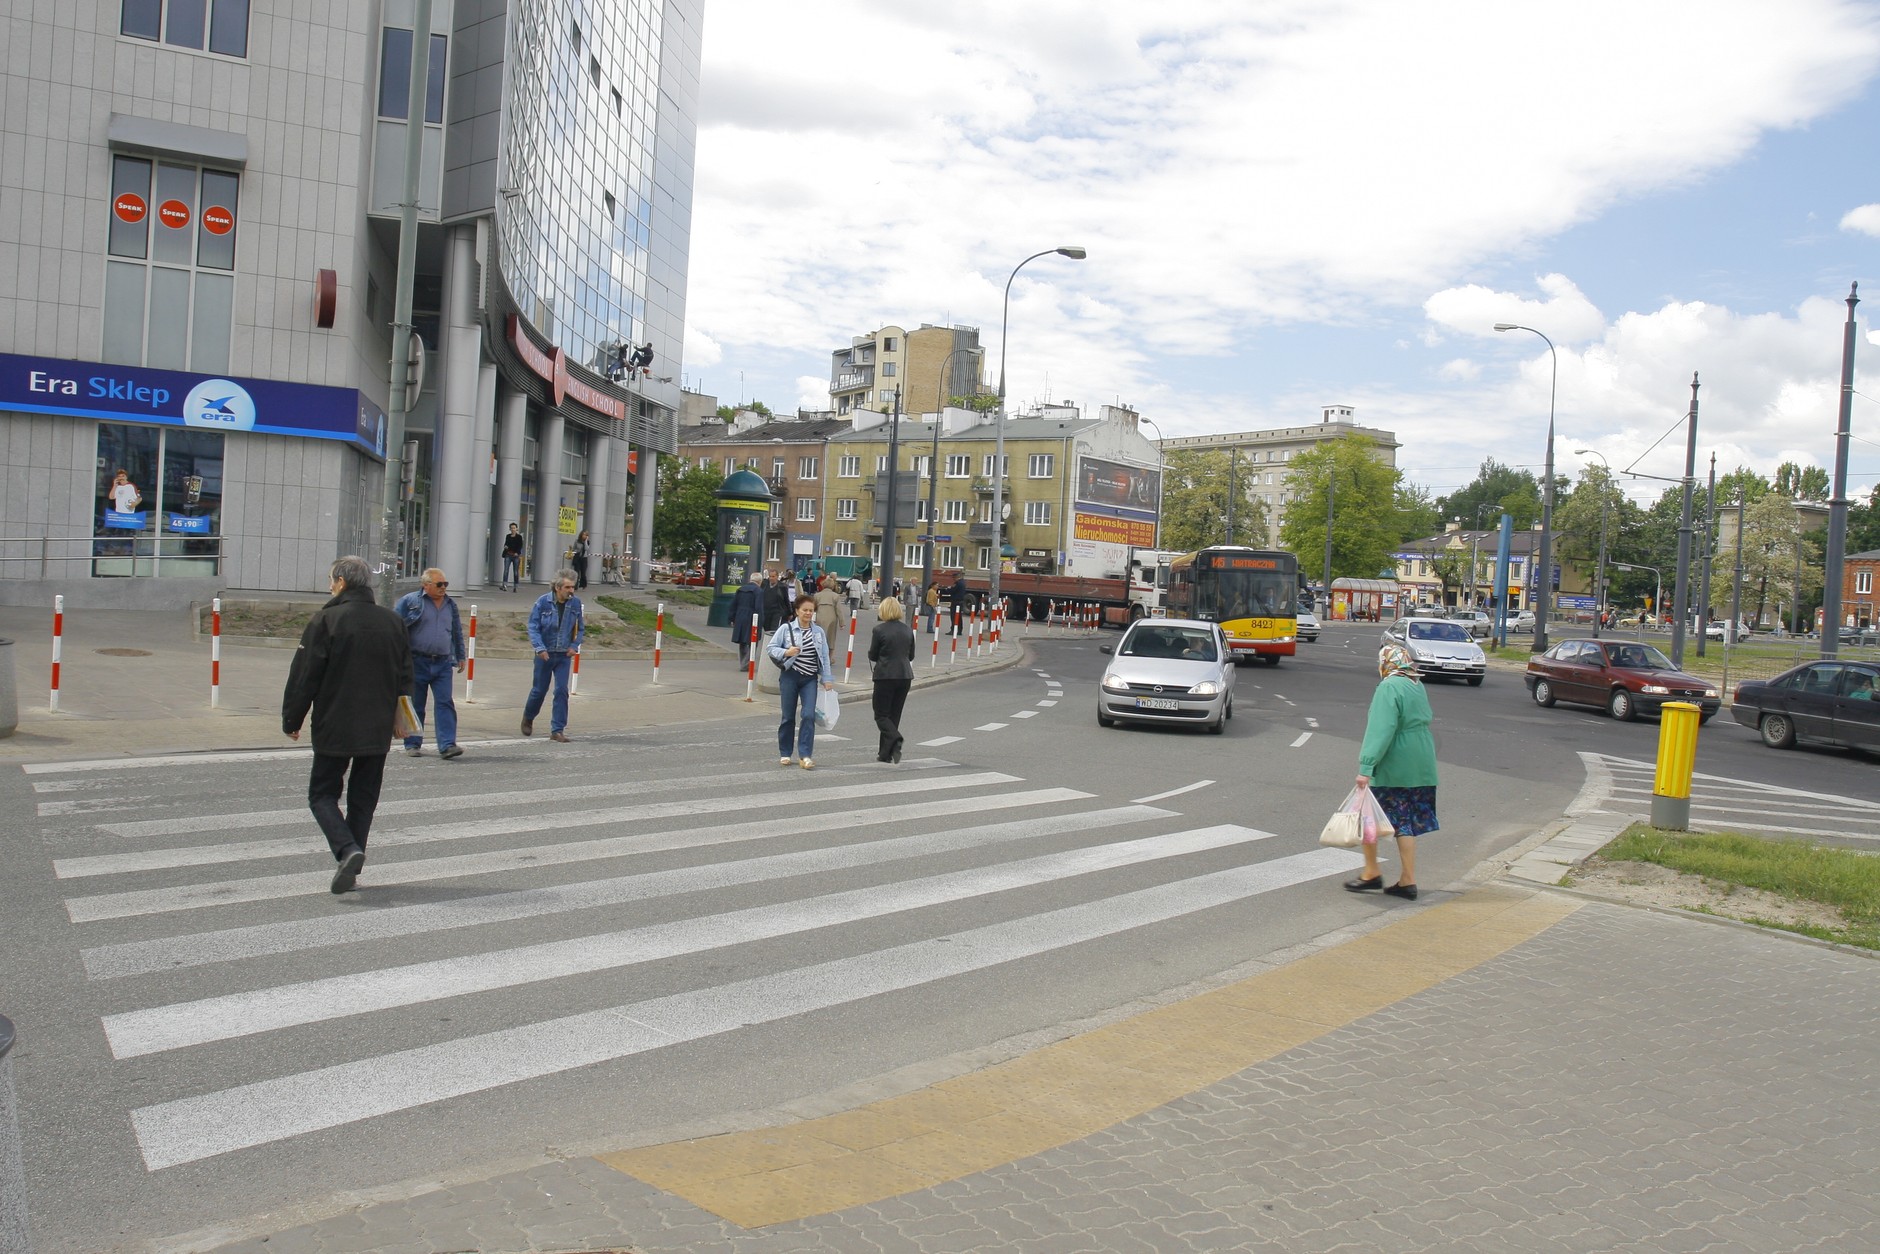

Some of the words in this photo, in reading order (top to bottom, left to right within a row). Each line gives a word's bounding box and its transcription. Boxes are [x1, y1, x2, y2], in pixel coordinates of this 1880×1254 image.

[29, 371, 78, 395] Era
[88, 376, 170, 409] Sklep
[568, 377, 589, 403] ENGLISH
[592, 392, 618, 416] SCHOOL
[200, 412, 236, 423] era
[1076, 514, 1129, 530] Gadomska
[1074, 525, 1128, 544] Nieruchomości
[1251, 619, 1273, 629] 8423
[1154, 700, 1177, 709] 20234
